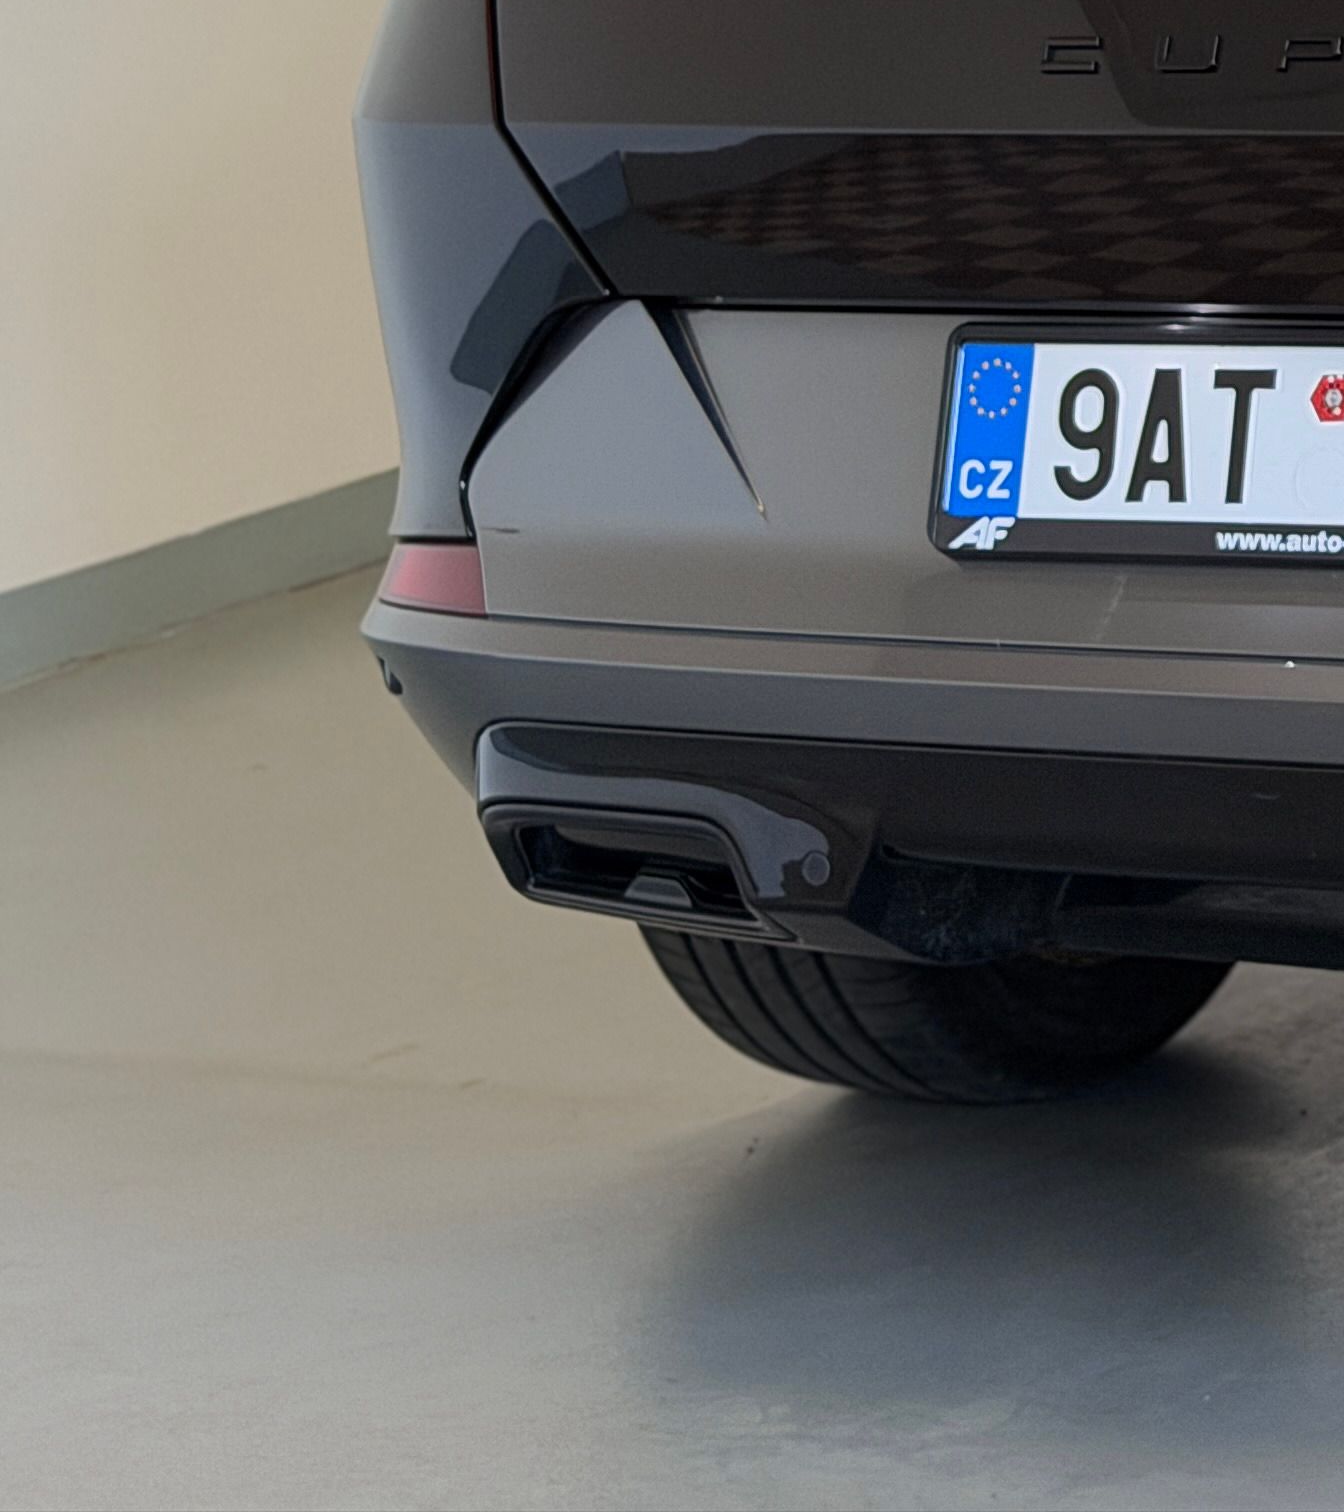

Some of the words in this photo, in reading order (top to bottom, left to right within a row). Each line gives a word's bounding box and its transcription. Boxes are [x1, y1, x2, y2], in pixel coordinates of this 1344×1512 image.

[1053, 367, 1278, 504] 9AT
[958, 459, 1014, 499] CZ
[948, 516, 1016, 550] AF
